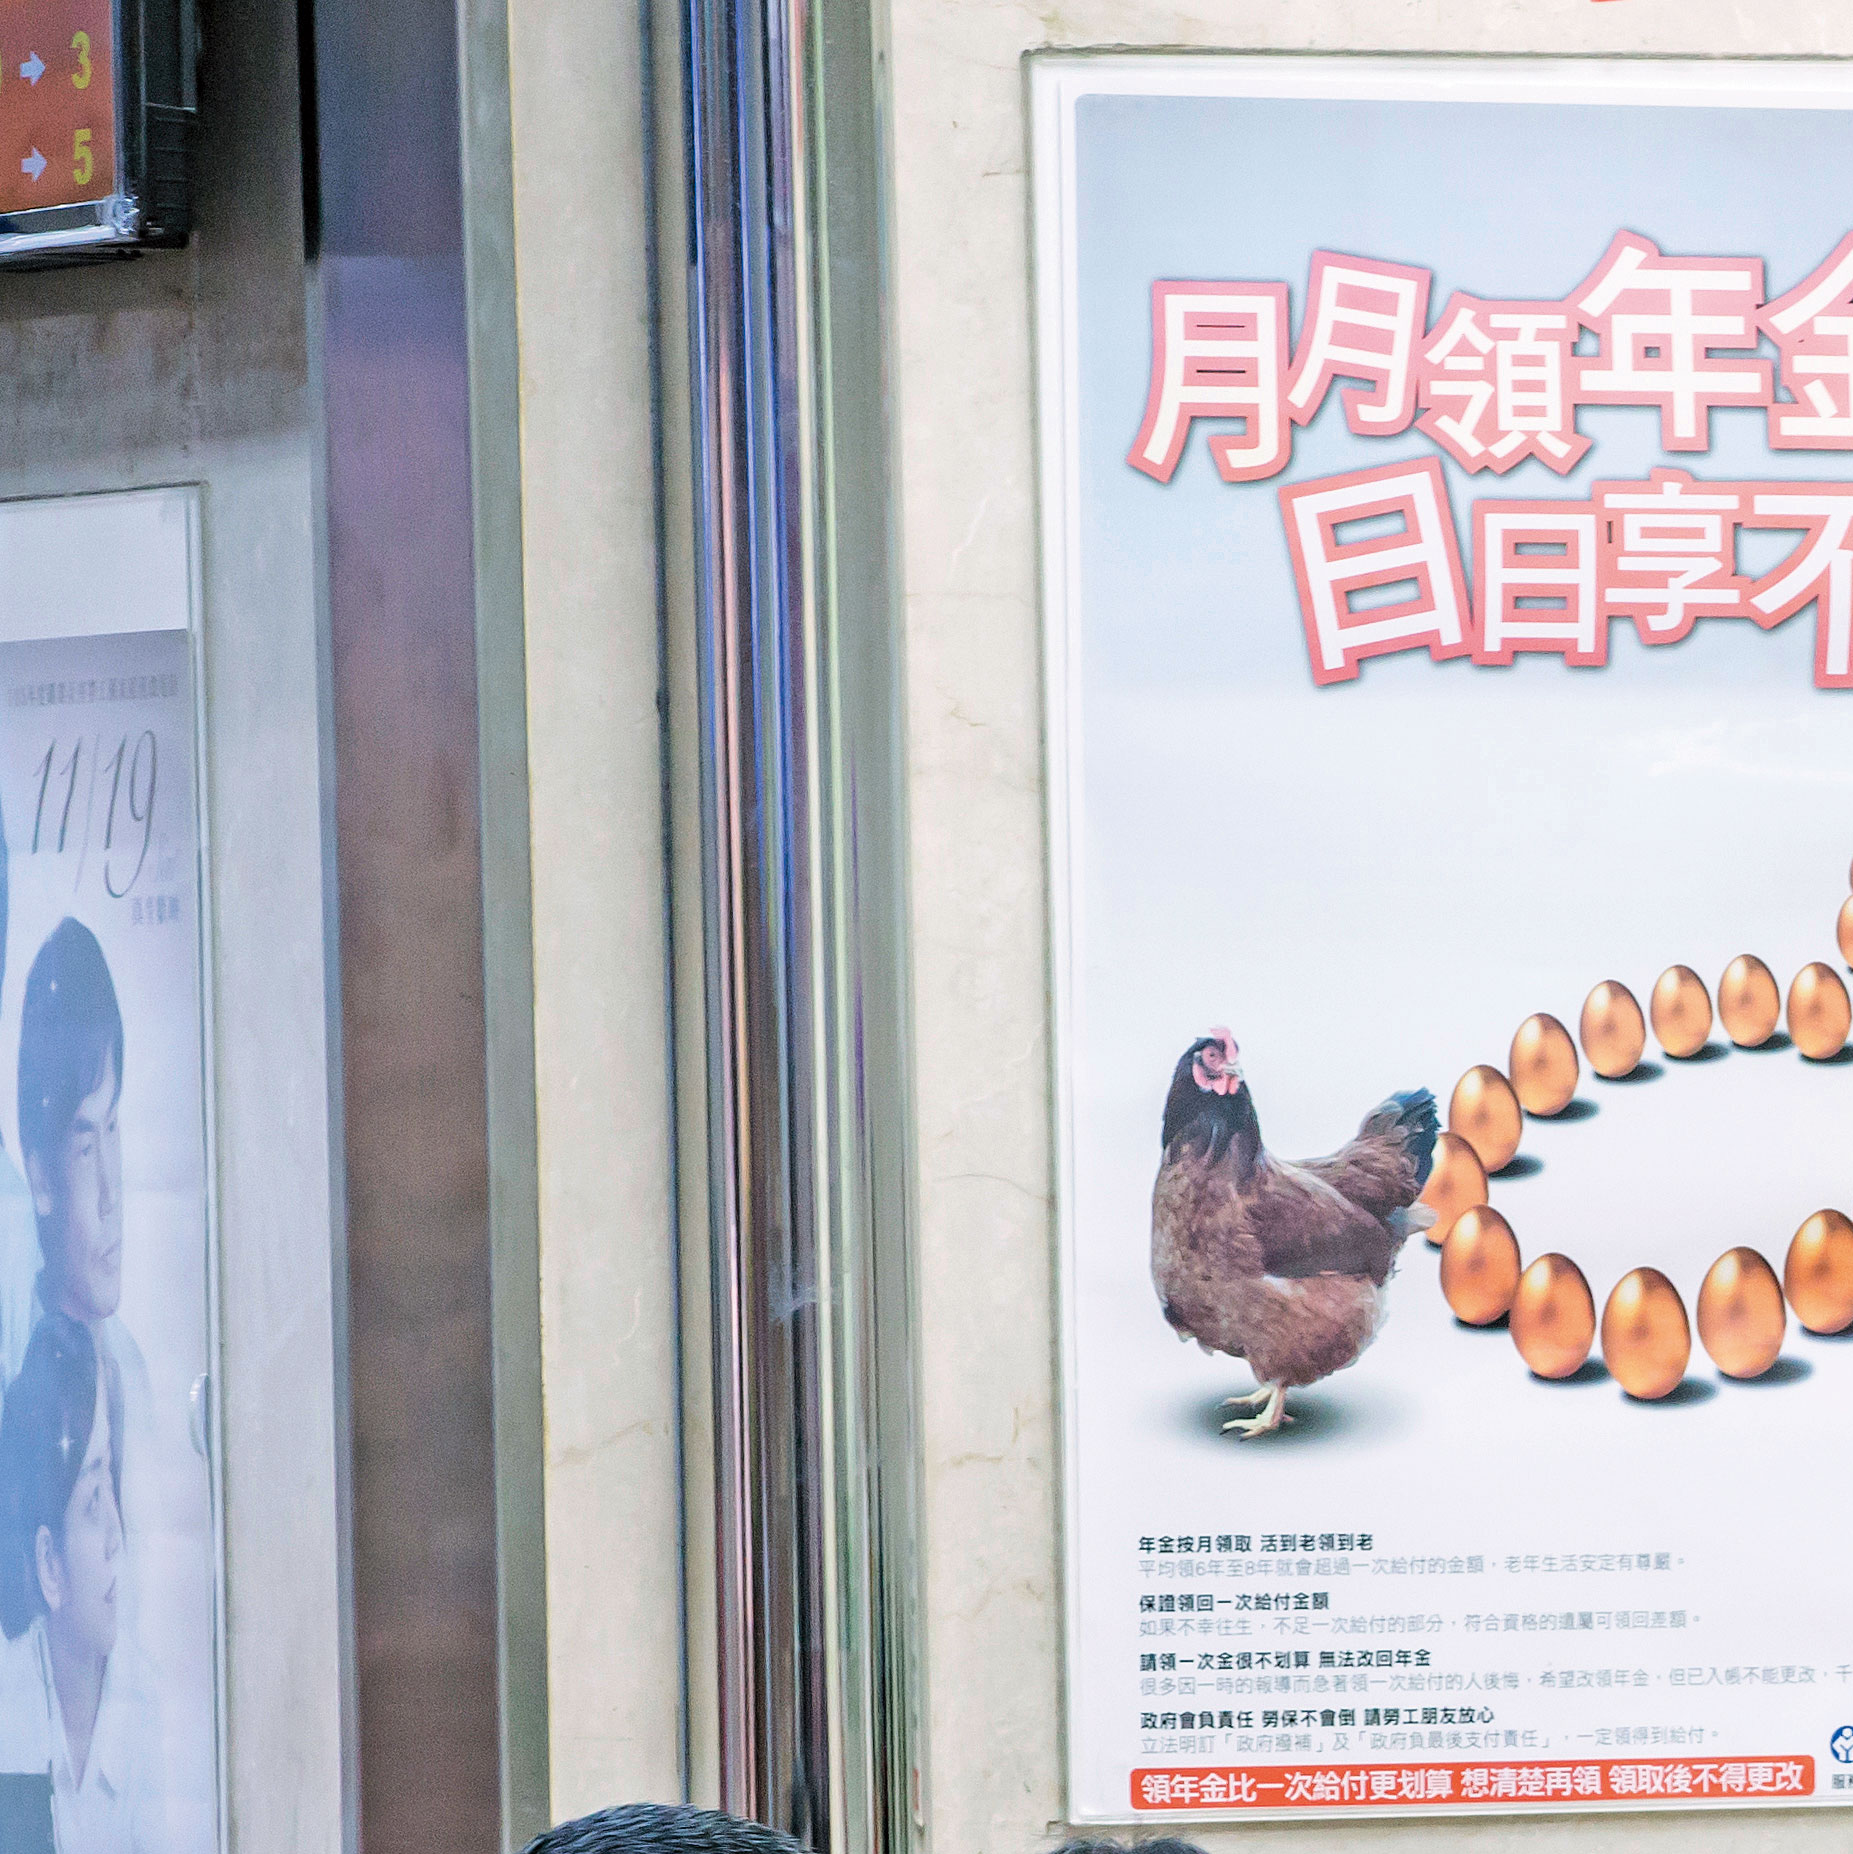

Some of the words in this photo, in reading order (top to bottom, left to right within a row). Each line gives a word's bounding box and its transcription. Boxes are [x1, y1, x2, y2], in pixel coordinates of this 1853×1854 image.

[70, 30, 91, 90] 3
[72, 128, 94, 185] 5
[1138, 1535, 1252, 1555] 年金按月領取
[1260, 1533, 1374, 1553] 活到老領到老
[1139, 1591, 1330, 1613] 保證領回一次給付金額
[1318, 1648, 1432, 1669] 無法改回年金
[1140, 1710, 1254, 1731] 政府會負責任
[1261, 1708, 1357, 1730] 勞保不會倒
[1363, 1705, 1495, 1727] 請勞工朋友放心
[1140, 1768, 1454, 1805] 領年金比一次給付更划算
[1460, 1764, 1602, 1800] 想清楚再領
[1609, 1762, 1805, 1795] 領取後不得更改
